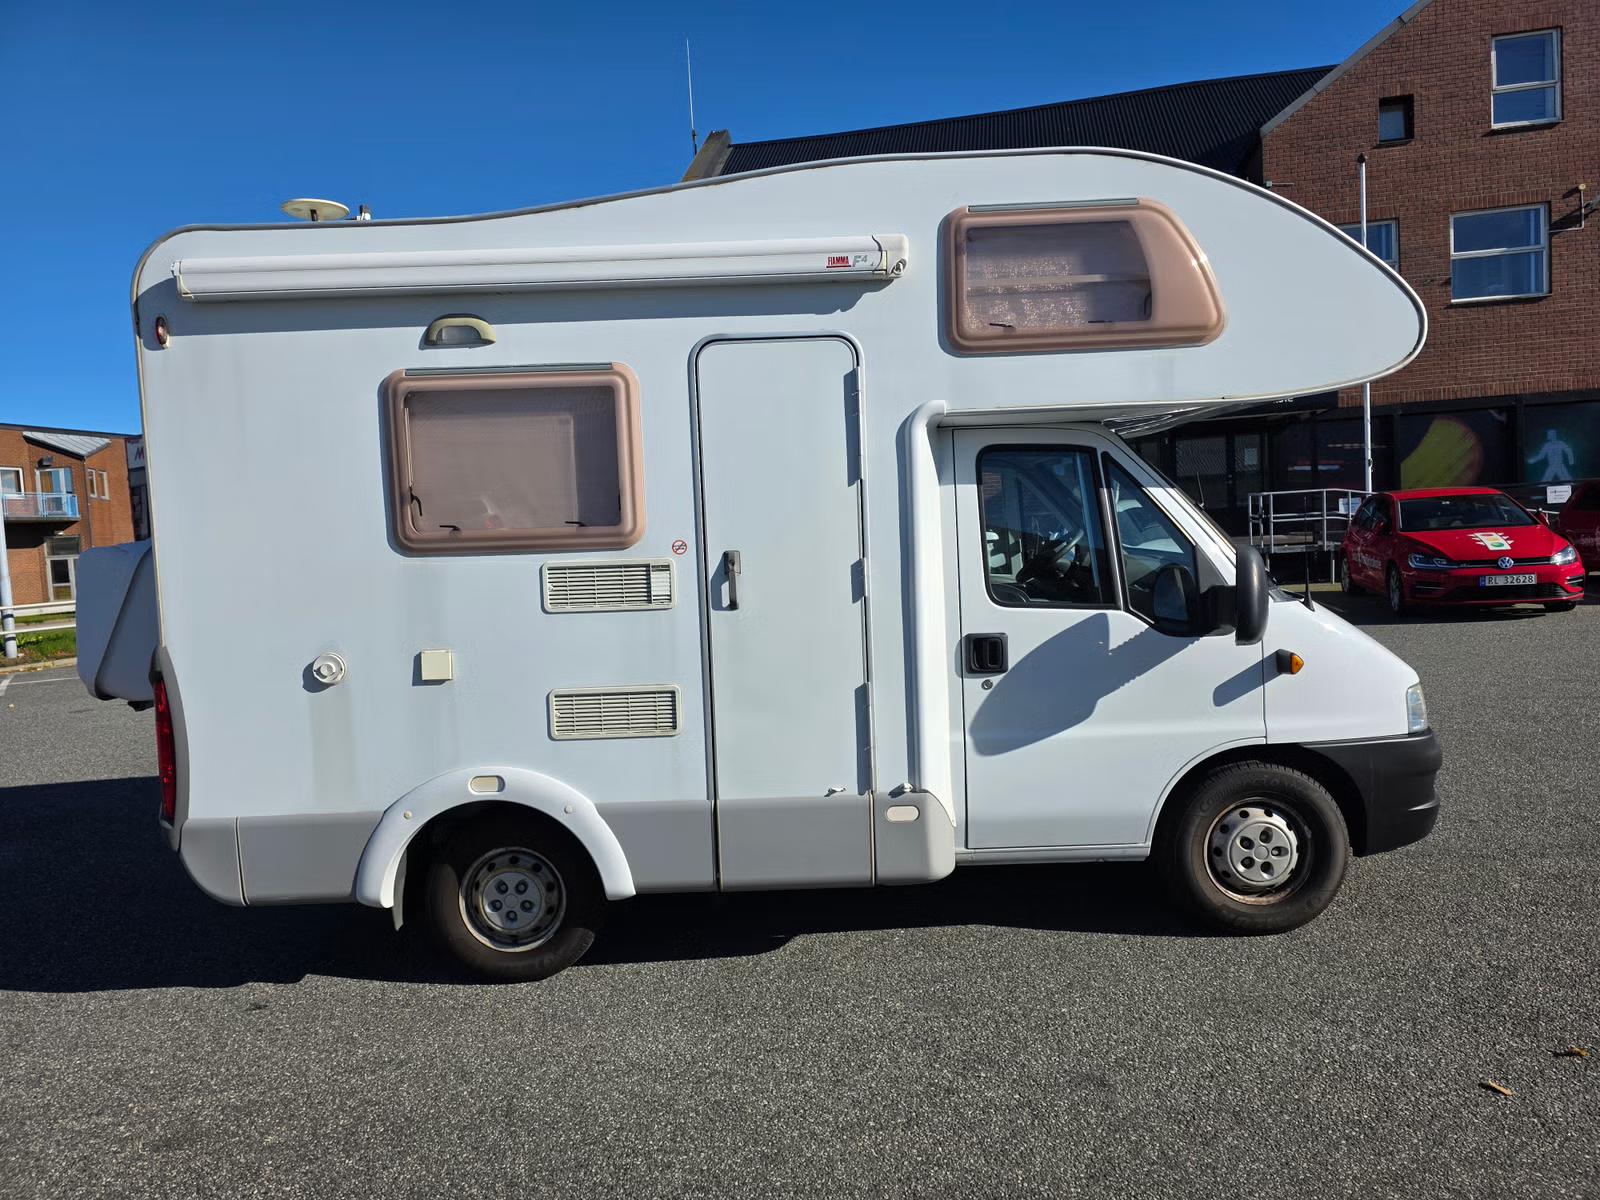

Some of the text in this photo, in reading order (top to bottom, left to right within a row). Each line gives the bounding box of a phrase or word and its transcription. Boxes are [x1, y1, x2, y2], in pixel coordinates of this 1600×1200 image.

[827, 256, 849, 265] FIAMMA
[1488, 574, 1534, 585] RL 32628
